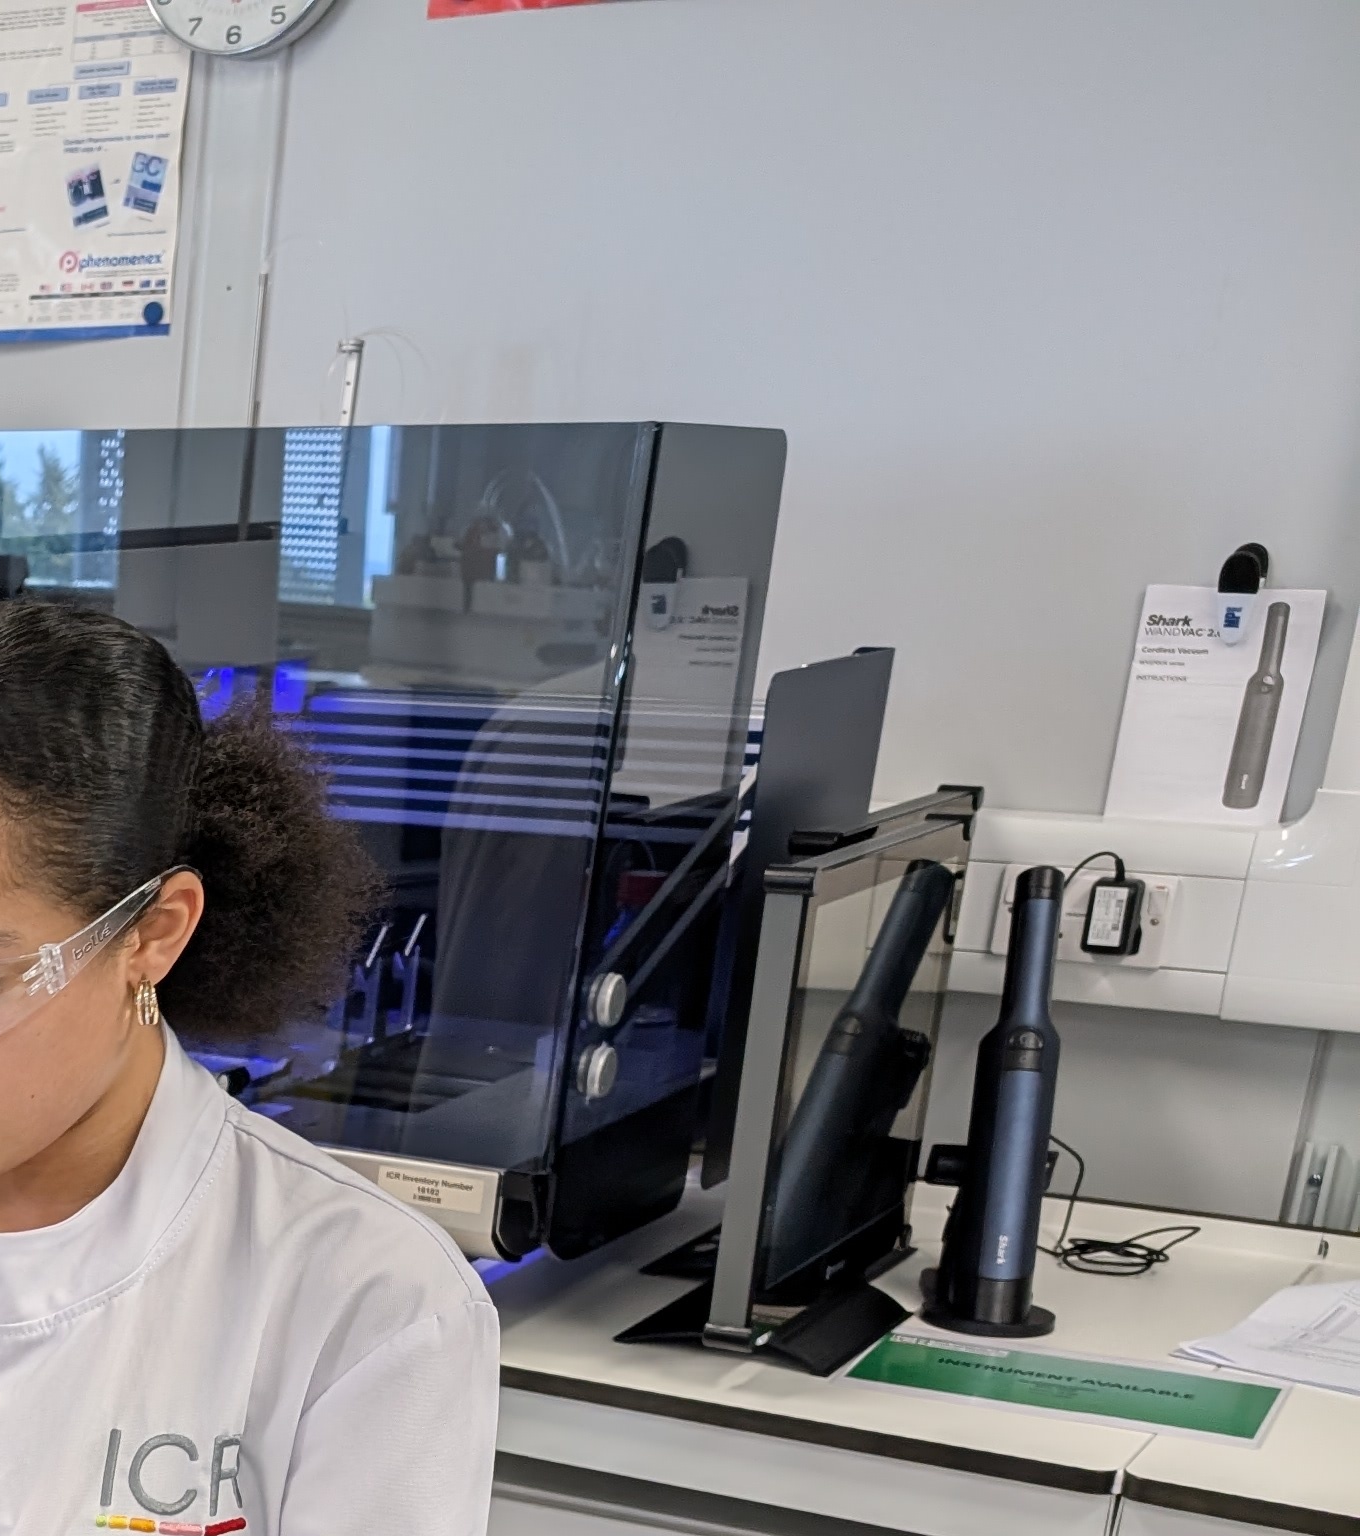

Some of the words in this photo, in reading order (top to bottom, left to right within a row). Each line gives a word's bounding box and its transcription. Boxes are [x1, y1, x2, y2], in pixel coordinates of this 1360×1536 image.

[269, 6, 286, 25] 5
[188, 18, 204, 37] 7
[225, 25, 243, 44] 6
[132, 152, 163, 176] GC
[79, 252, 163, 271] phenomenex
[1146, 614, 1194, 627] Shark
[402, 1173, 440, 1188] Inventory
[100, 1428, 246, 1518] ICR
